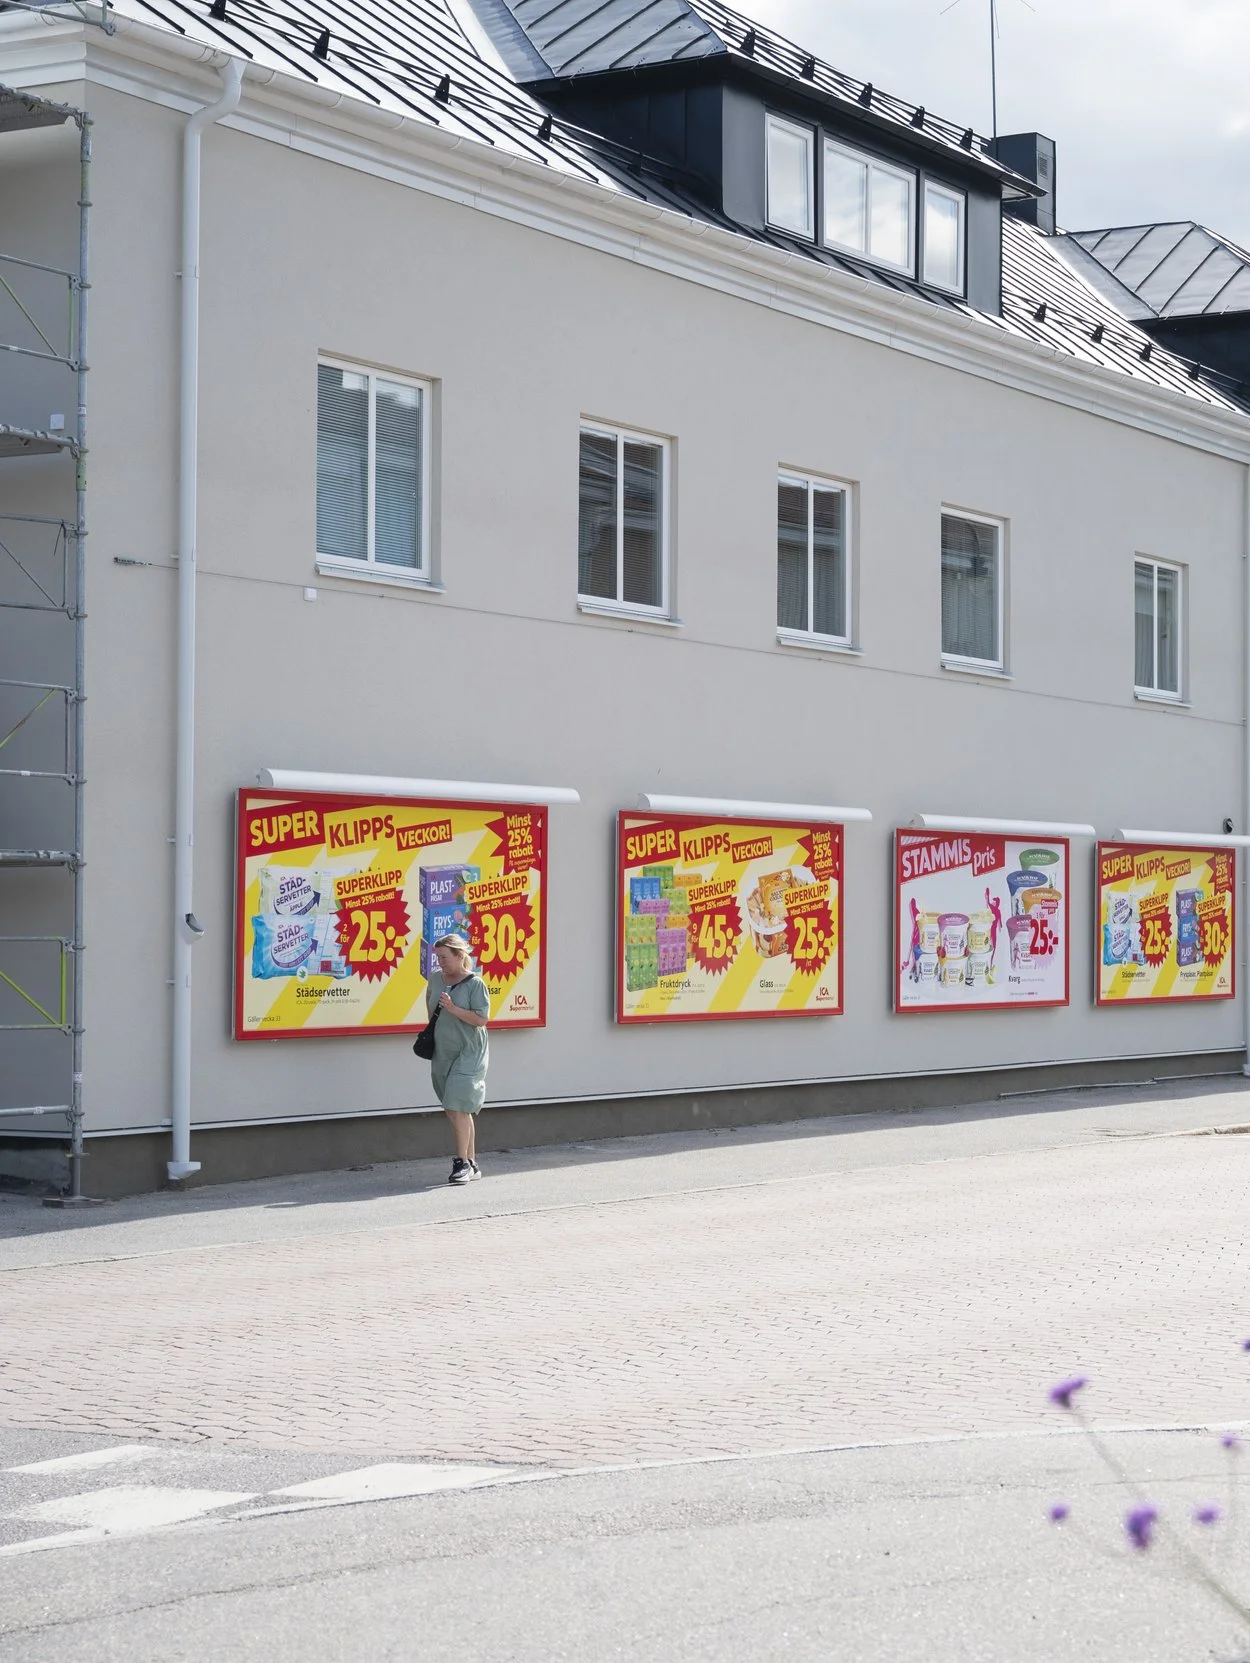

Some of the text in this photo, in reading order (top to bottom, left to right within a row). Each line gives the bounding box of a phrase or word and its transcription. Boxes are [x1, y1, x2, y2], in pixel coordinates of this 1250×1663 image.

[506, 813, 532, 829] Minst
[250, 810, 451, 849] SUPER KLIPPS VECKOR!
[507, 827, 533, 847] 25%
[812, 830, 831, 844] Minst
[509, 844, 534, 859] rabatt
[626, 829, 772, 862] SUPER KLIPPS VECKOR!
[813, 842, 832, 860] 25%
[902, 838, 996, 878] STAMMIS pris
[1102, 854, 1133, 880] SUPER
[1136, 856, 1165, 879] KLIPPS
[336, 870, 402, 895] SUPERKLIPP
[430, 880, 455, 894] PLAST-
[468, 875, 528, 900] SUPERKLIPP
[276, 885, 312, 906] SERVETTER
[688, 879, 737, 901] SUPERKLIPP
[784, 884, 829, 905] SUPERKLIPP
[345, 899, 361, 909] Minst
[361, 895, 376, 905] 25%
[476, 903, 491, 912] Minst
[491, 900, 503, 908] 25%
[343, 924, 347, 932] 2
[433, 915, 454, 929] FRYS-
[692, 923, 698, 934] 9
[474, 926, 479, 934] 3
[273, 933, 309, 954] SERVETTER
[340, 934, 350, 943] för
[471, 936, 480, 944] för
[660, 979, 692, 989] Fruktdryck
[760, 980, 774, 988] Glass
[296, 987, 350, 998] Städservetter
[819, 987, 829, 996] ICA
[514, 995, 528, 1006] ICA
